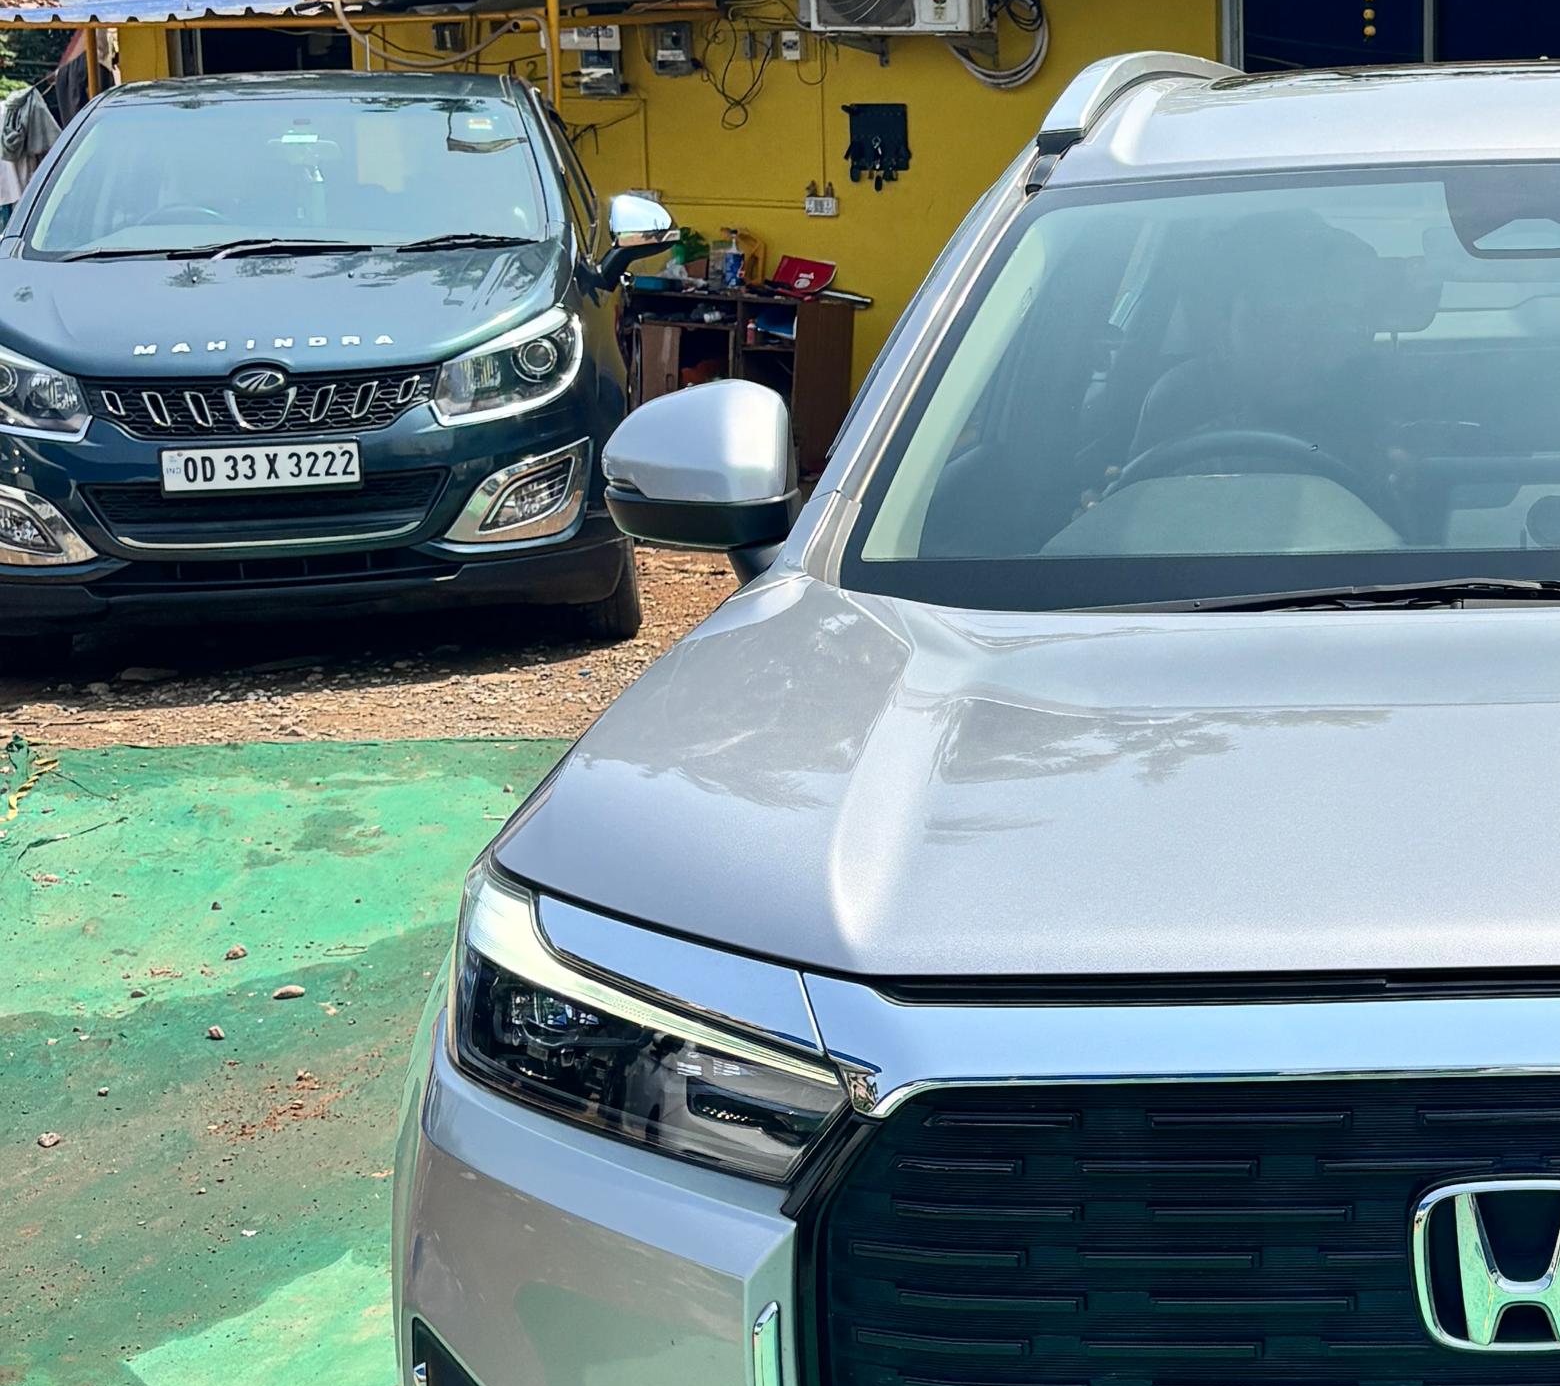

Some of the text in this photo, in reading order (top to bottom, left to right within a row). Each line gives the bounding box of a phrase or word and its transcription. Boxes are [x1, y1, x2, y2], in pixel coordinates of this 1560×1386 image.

[133, 334, 394, 356] MAHINDRA
[225, 454, 257, 481] 33
[264, 452, 280, 480] X
[287, 449, 356, 477] 3222
